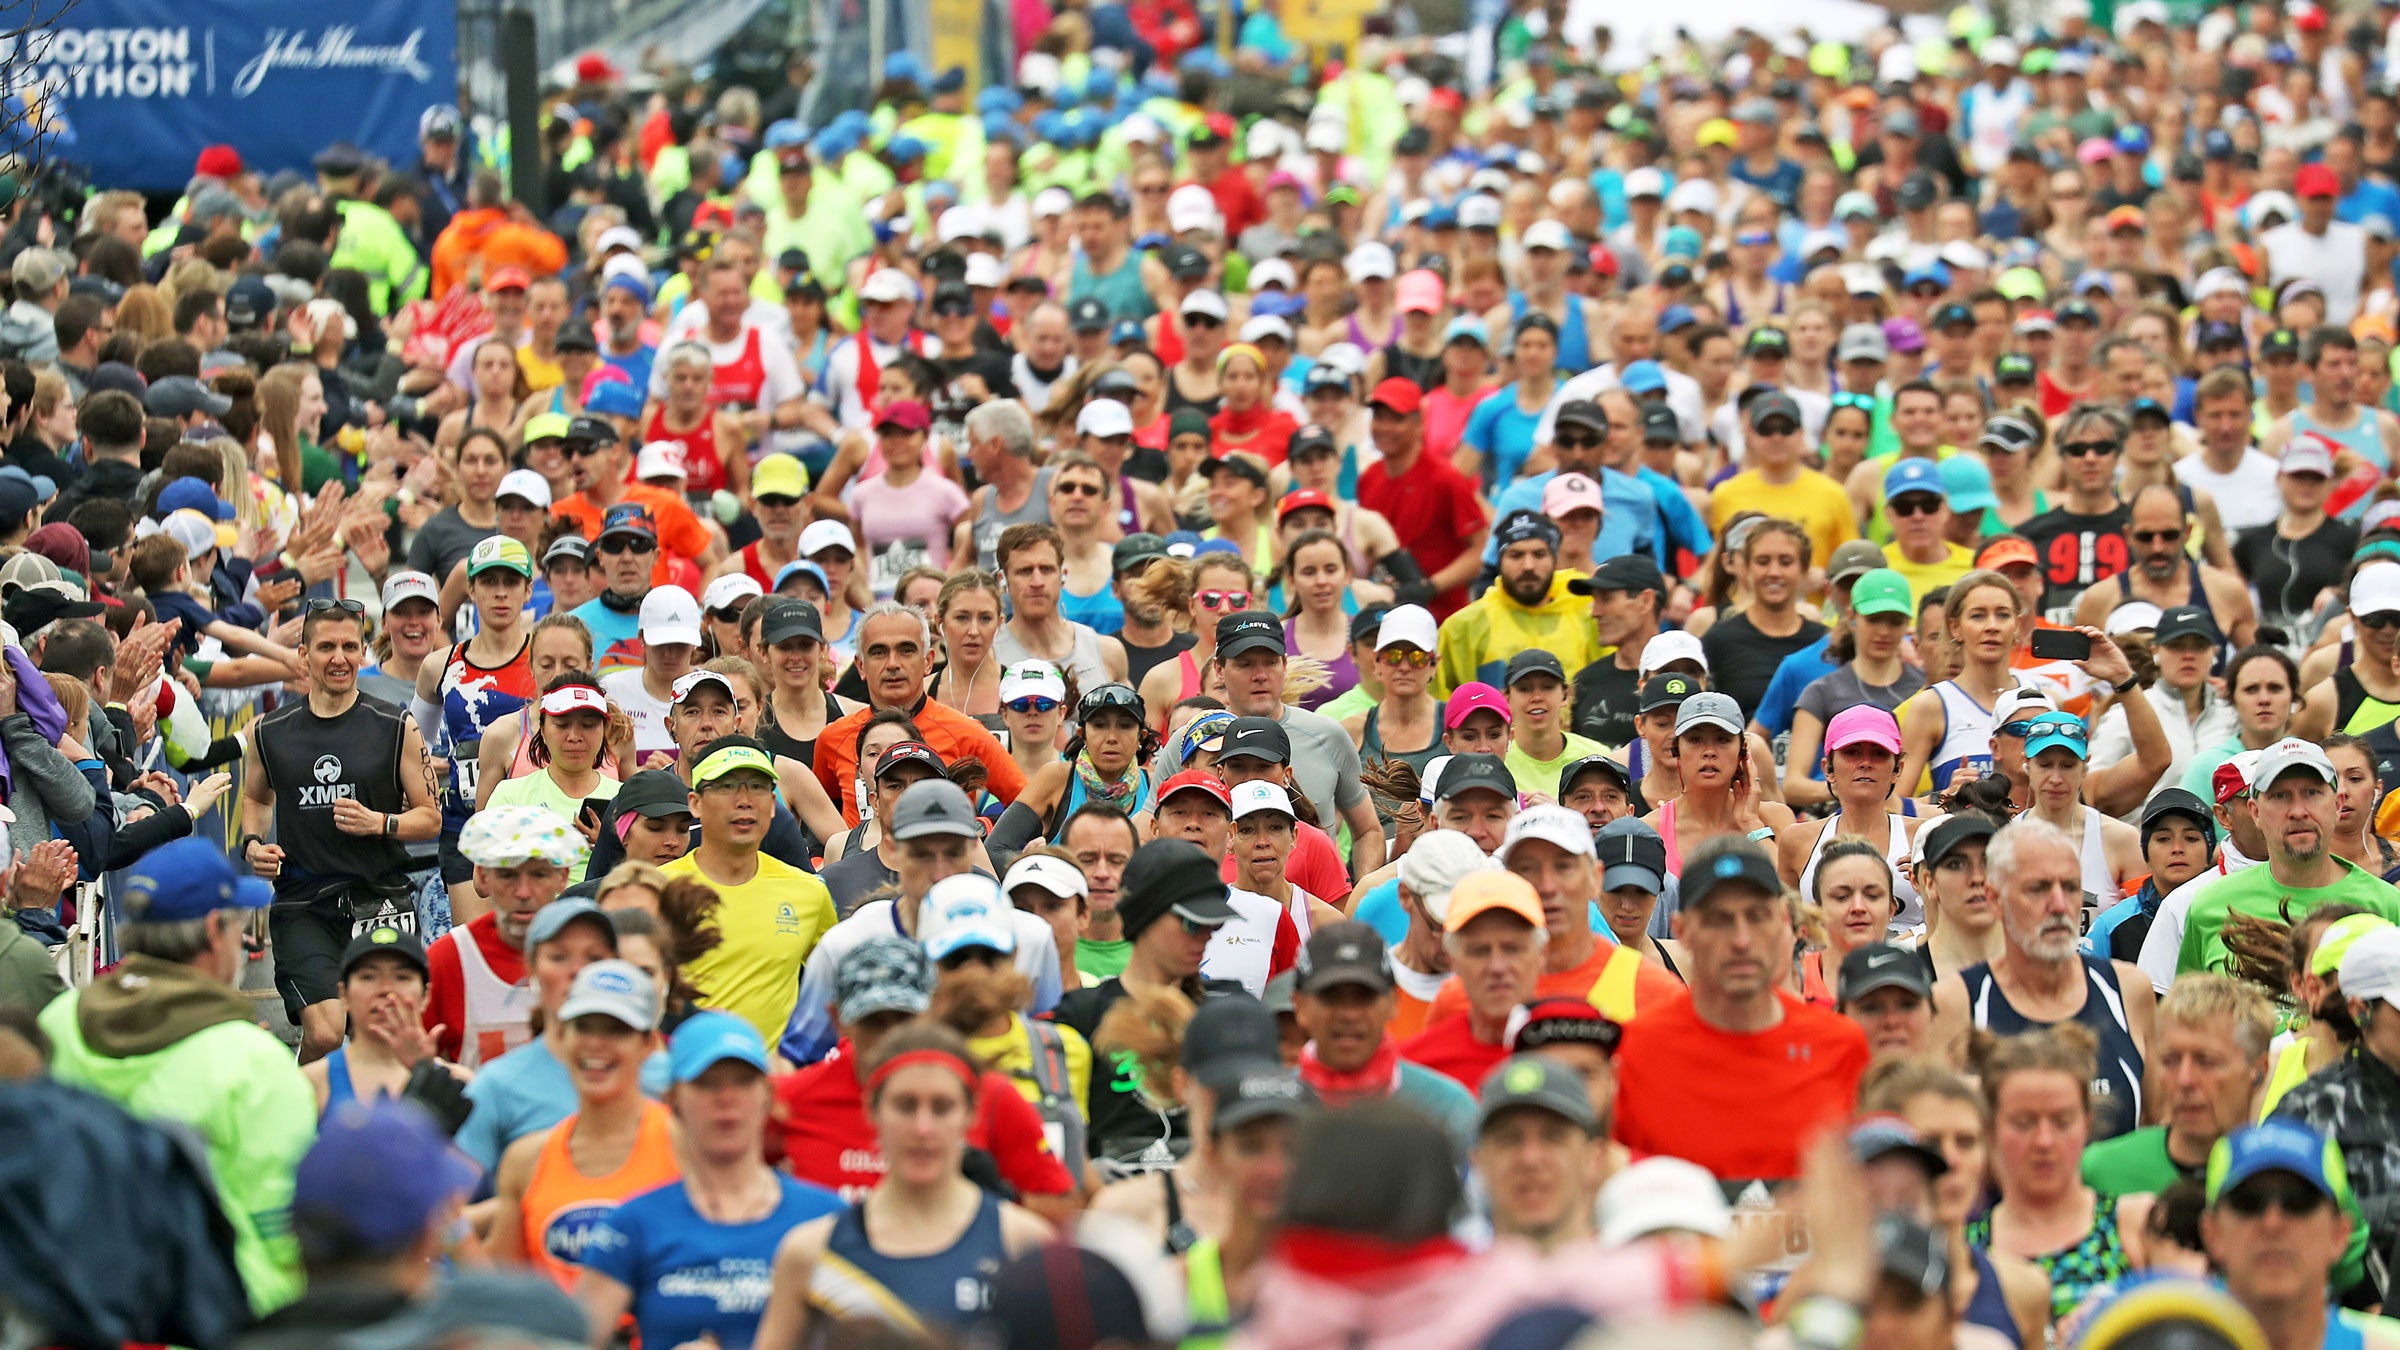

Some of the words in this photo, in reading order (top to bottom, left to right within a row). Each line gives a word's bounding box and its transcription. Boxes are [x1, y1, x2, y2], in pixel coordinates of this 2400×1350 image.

[27, 27, 190, 64] BOSTON
[0, 62, 192, 98] RATHON
[623, 709, 647, 719] RUN
[298, 784, 351, 806] XMP
